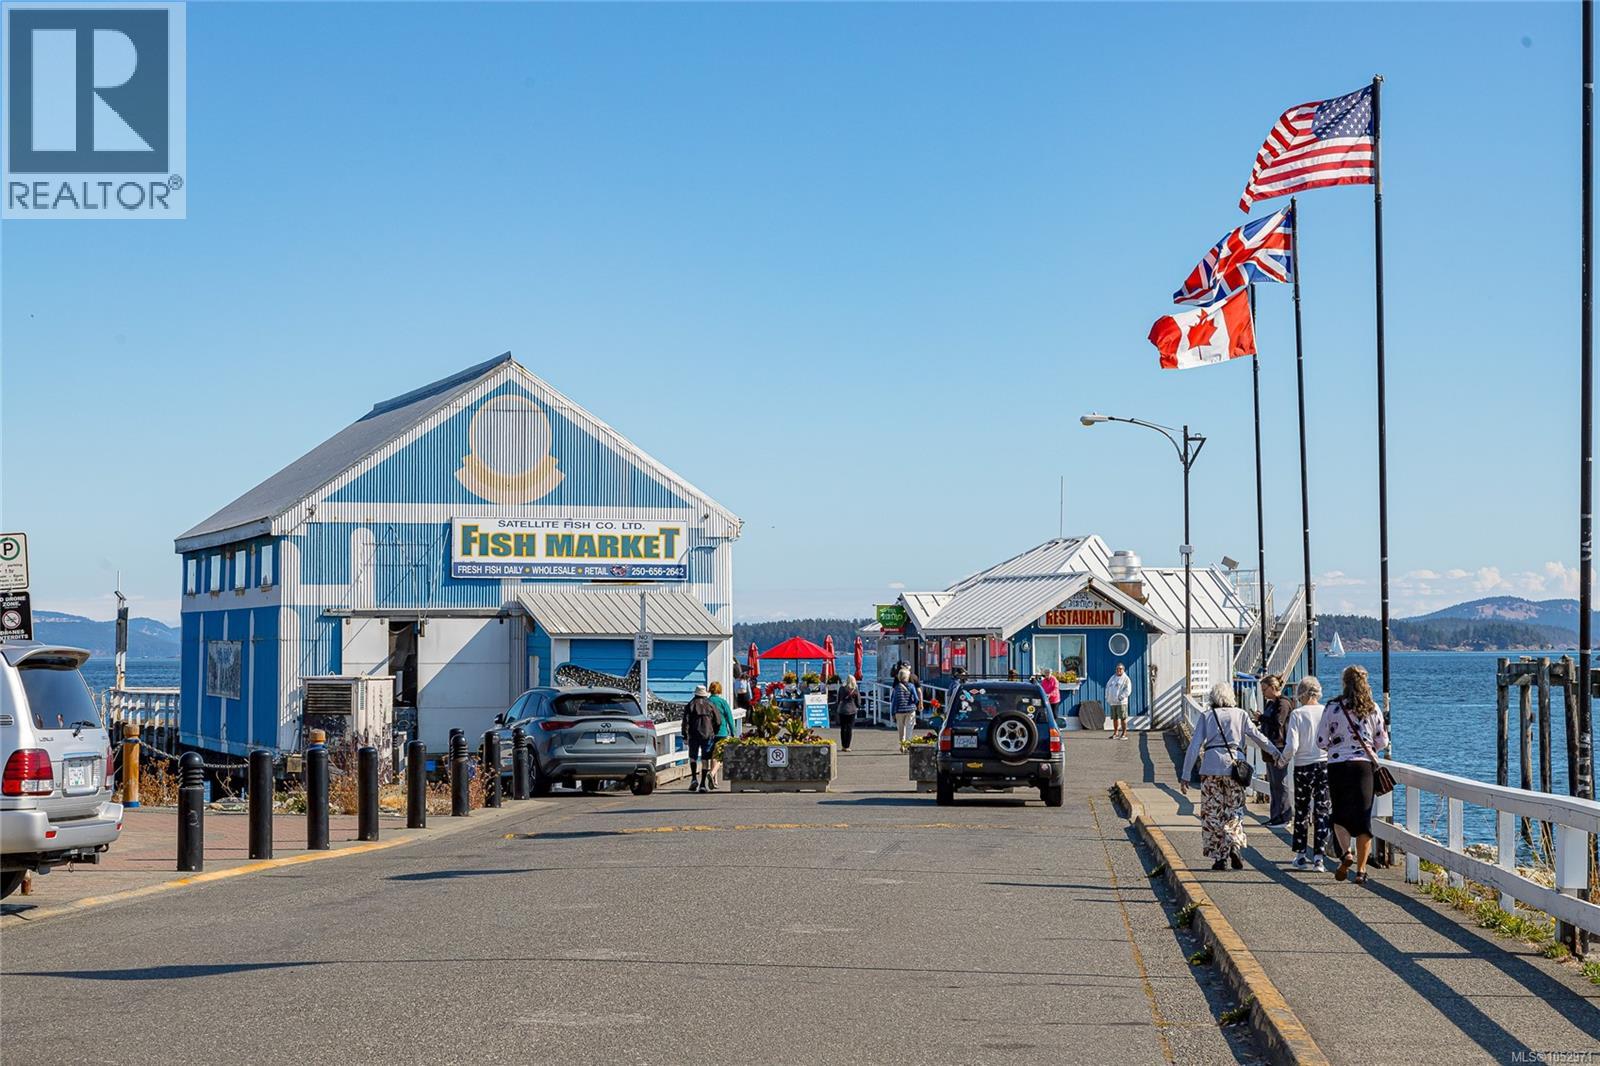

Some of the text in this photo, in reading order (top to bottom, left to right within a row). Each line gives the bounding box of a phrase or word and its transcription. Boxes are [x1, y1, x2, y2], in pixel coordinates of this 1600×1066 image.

[498, 519, 646, 530] SATELLITE FISH CO. LTD.
[461, 524, 680, 559] FISH MARKET
[3, 542, 13, 555] P
[457, 565, 684, 576] FRESH FISH DAILY WHOLESALE RETAIL 250-656-2642
[1046, 610, 1115, 625] RESTAURANT
